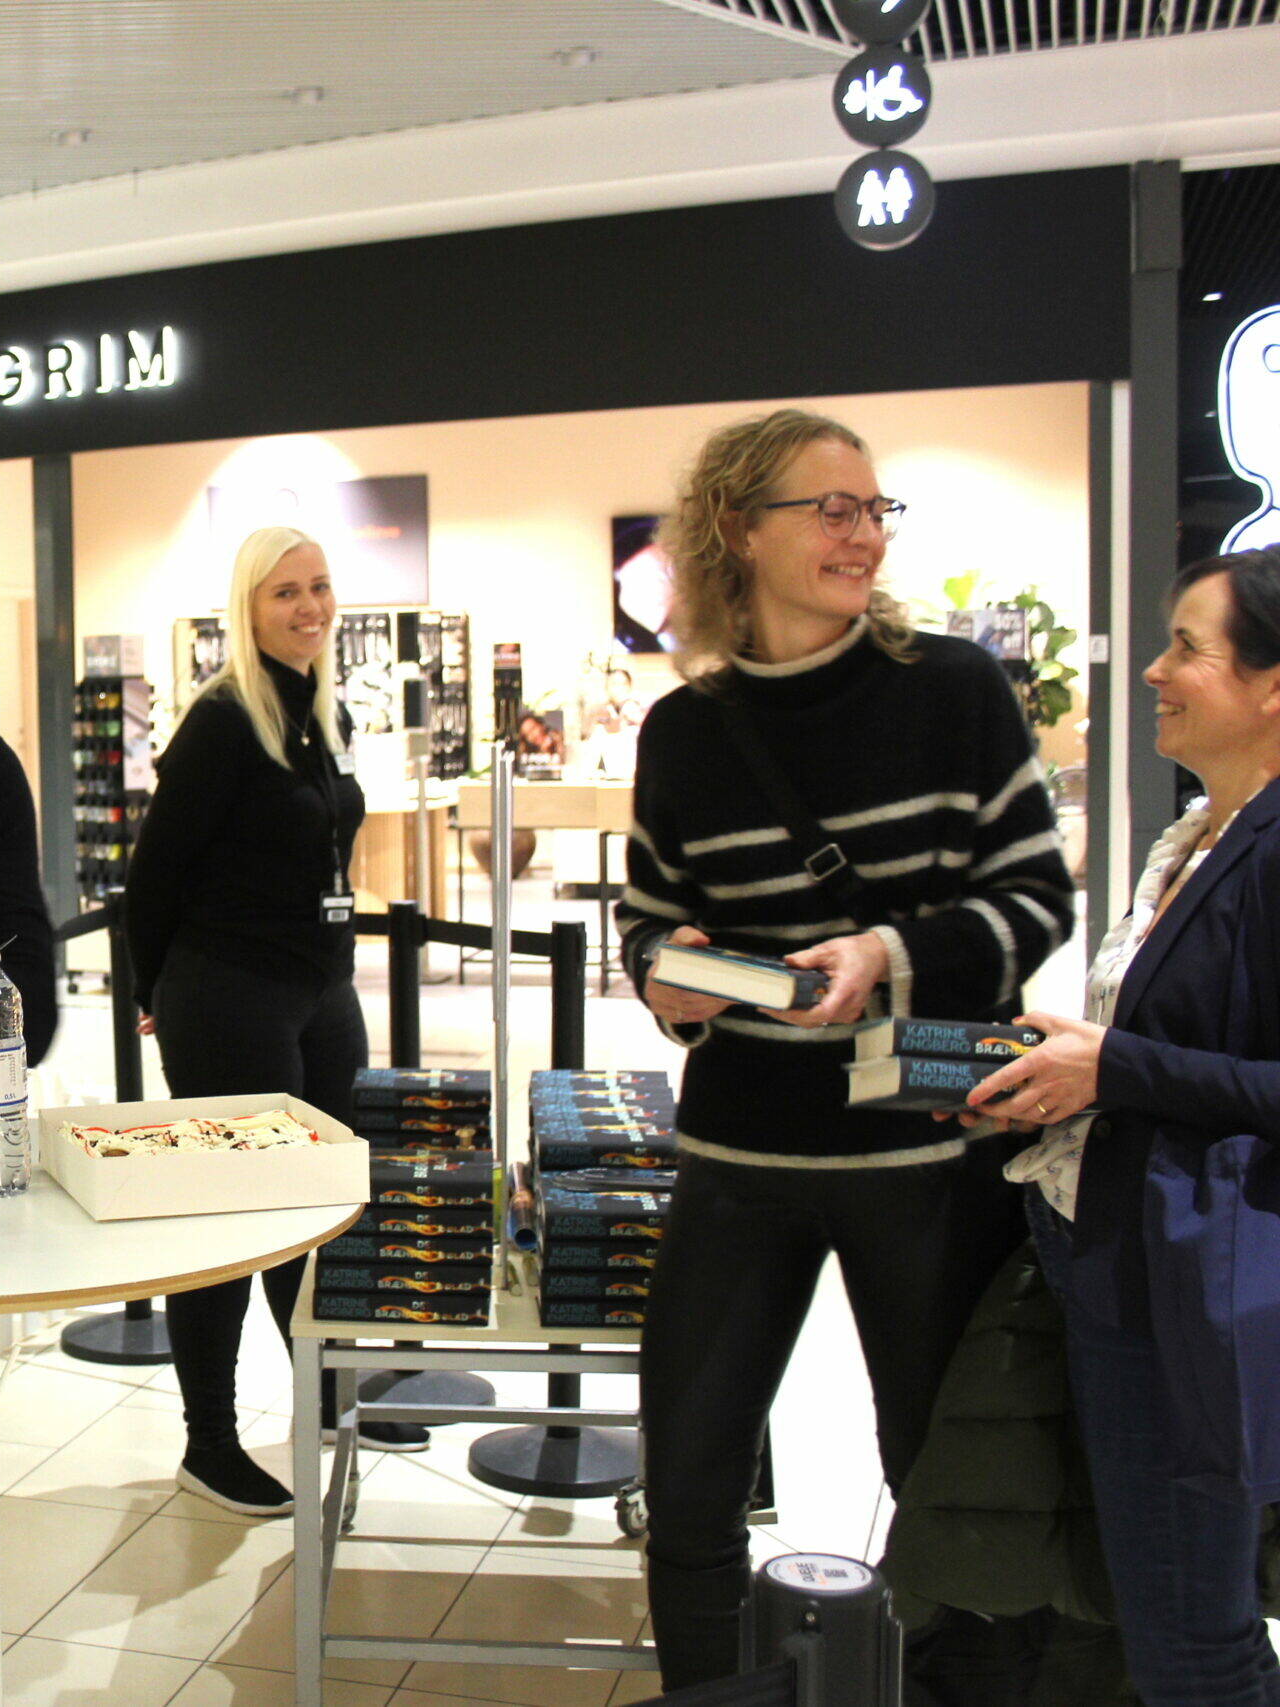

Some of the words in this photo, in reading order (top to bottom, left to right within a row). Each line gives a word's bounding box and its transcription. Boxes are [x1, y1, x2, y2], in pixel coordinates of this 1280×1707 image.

[906, 1025, 967, 1040] KATRINE
[901, 1037, 970, 1054] ENGBERG
[912, 1061, 970, 1076] KATRINE
[908, 1073, 975, 1090] ENGBERG
